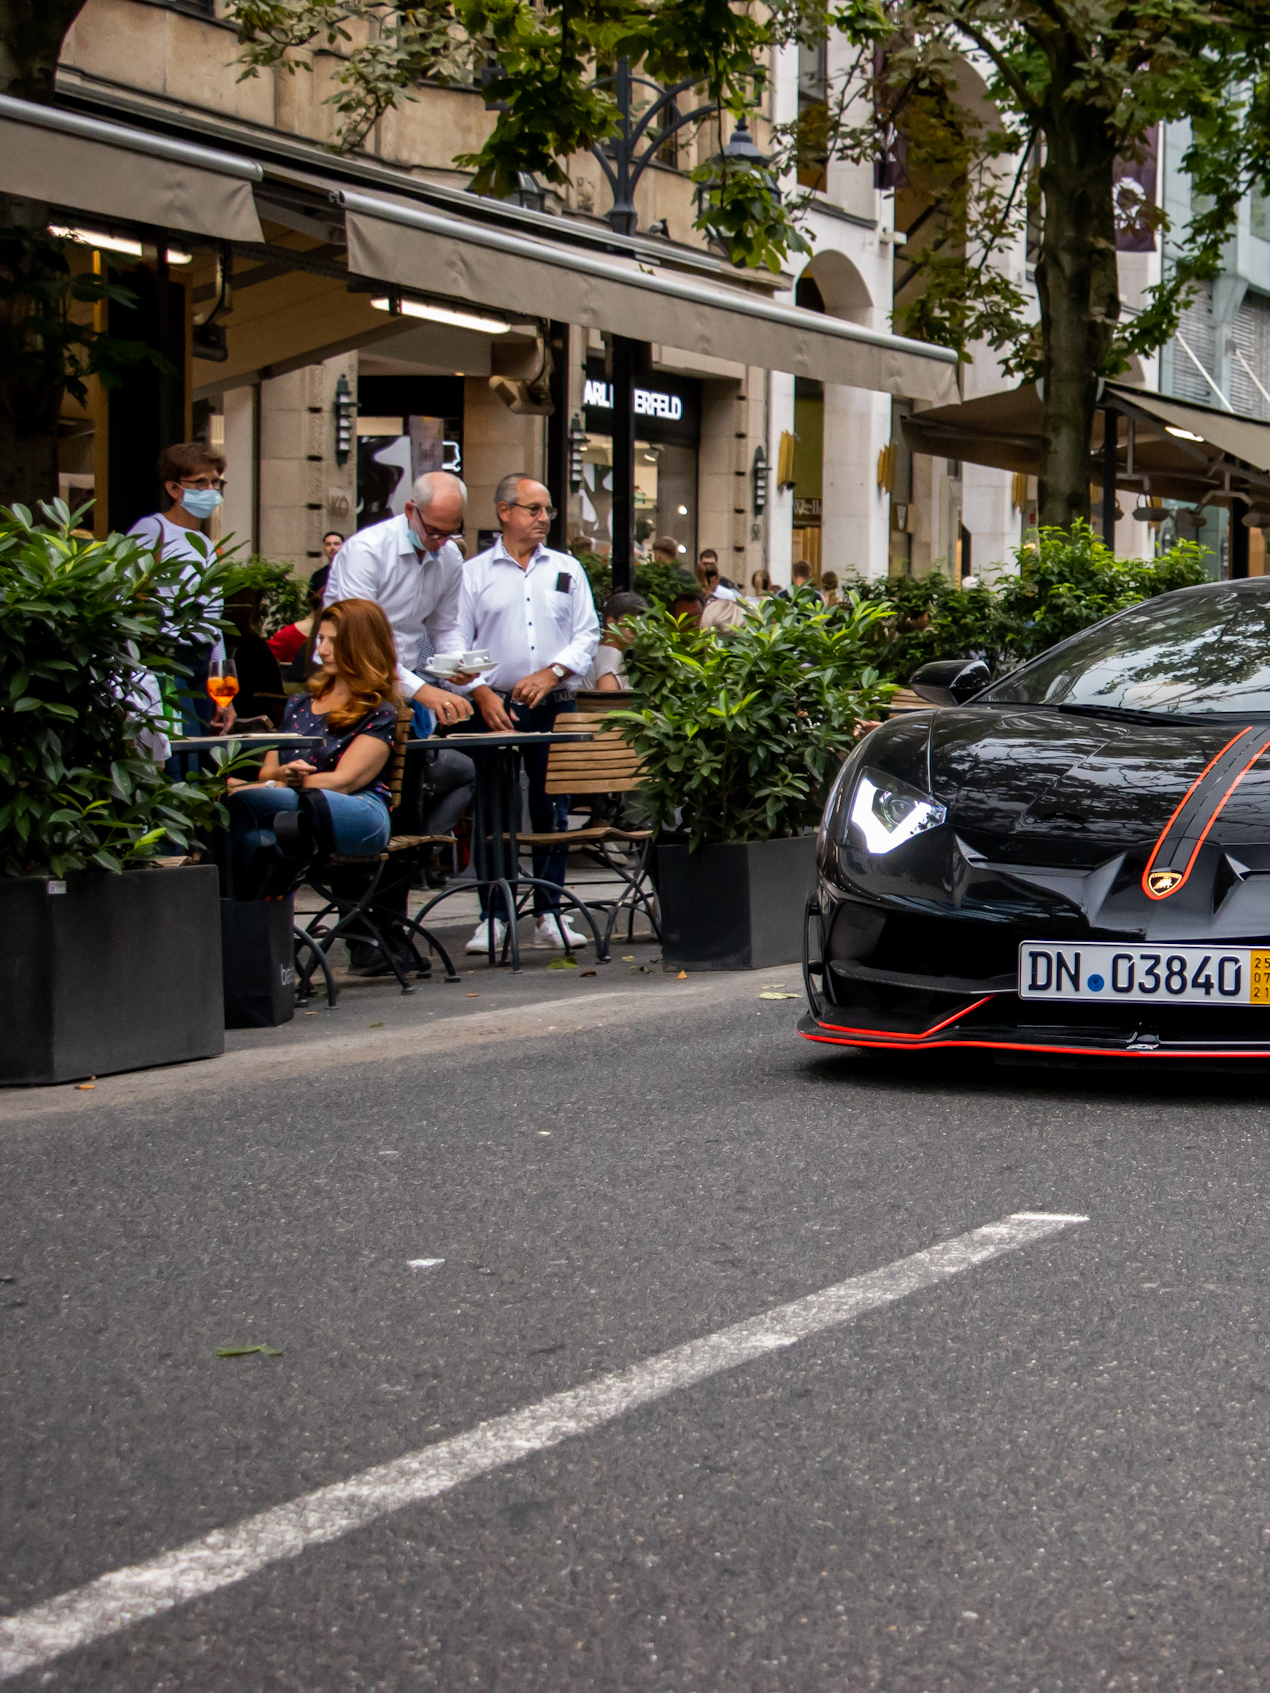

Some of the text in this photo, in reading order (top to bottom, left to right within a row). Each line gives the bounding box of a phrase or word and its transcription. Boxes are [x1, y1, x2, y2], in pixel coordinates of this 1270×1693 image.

[583, 379, 609, 408] ARL
[1255, 957, 1270, 968] 25
[1028, 951, 1241, 996] DN 03840
[1254, 972, 1270, 983] 07
[1254, 987, 1269, 998] 21
